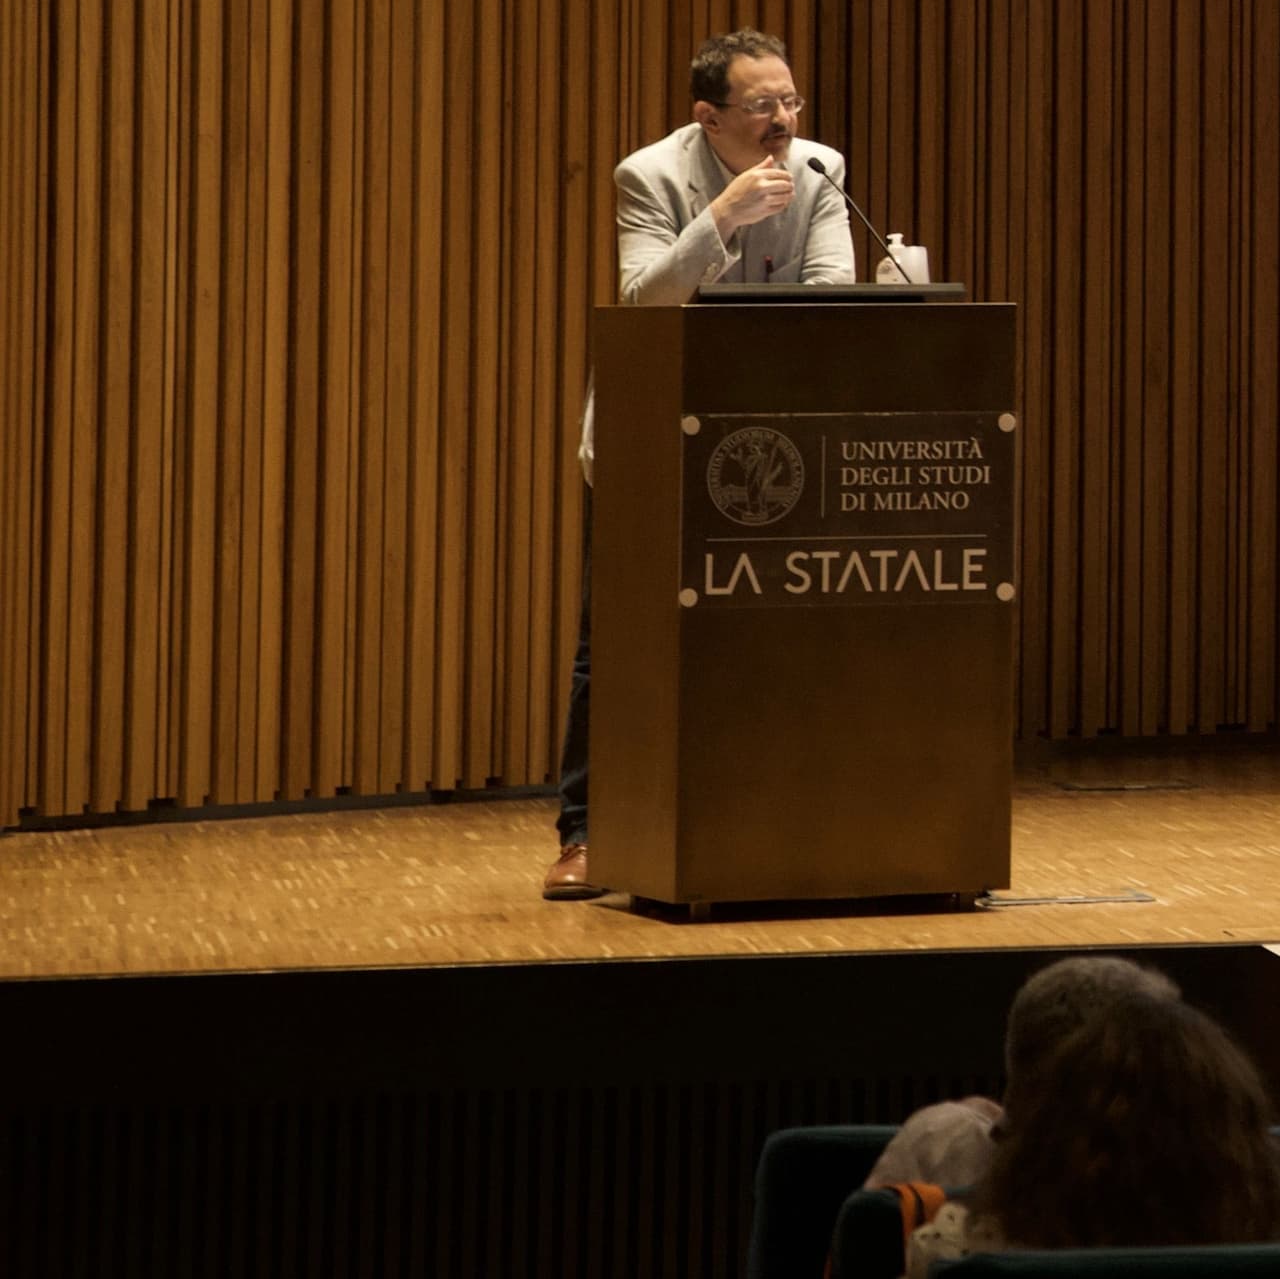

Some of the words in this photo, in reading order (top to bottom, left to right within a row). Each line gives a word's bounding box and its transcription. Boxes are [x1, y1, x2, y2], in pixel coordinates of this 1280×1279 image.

[841, 437, 984, 460] UNIVERSITÀ
[840, 467, 912, 487] DEGLI
[917, 466, 991, 485] STUDI
[840, 493, 867, 512] DI
[873, 491, 970, 511] MILANO
[704, 552, 763, 596] LA
[783, 548, 988, 595] STATALE
